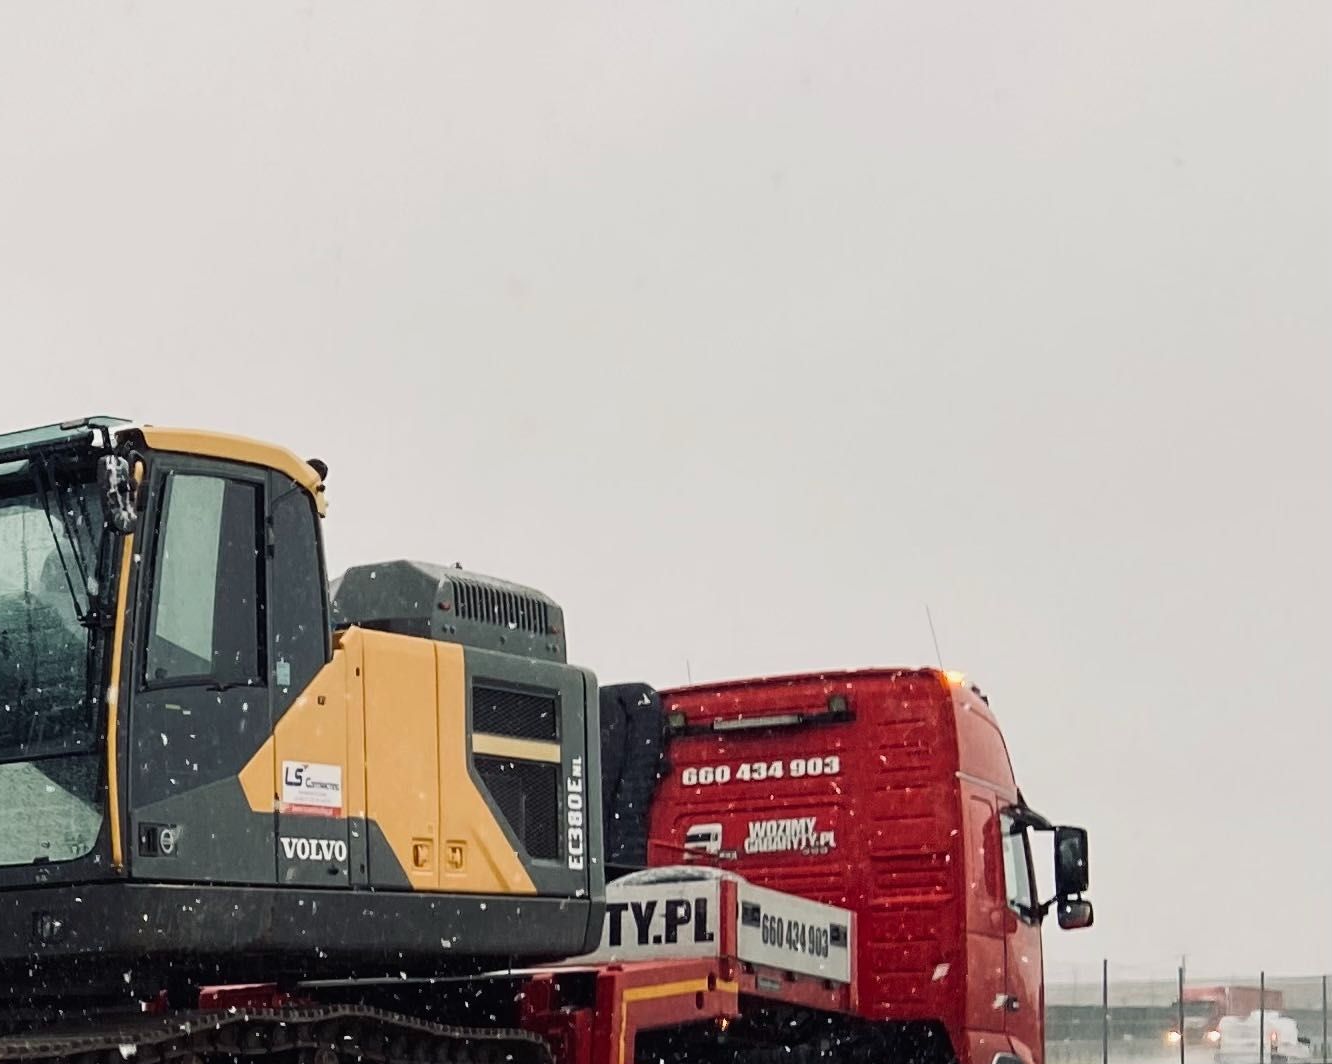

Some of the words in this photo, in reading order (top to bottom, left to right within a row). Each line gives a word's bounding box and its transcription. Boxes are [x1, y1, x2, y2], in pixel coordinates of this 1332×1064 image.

[285, 766, 304, 787] LS
[682, 765, 731, 786] 660
[736, 760, 784, 781] 434
[789, 755, 840, 777] 903
[748, 817, 817, 843] WOZIMY
[280, 837, 347, 862] VOLVO
[762, 913, 784, 948] 660
[786, 920, 806, 952] 434
[808, 925, 829, 958] 903
